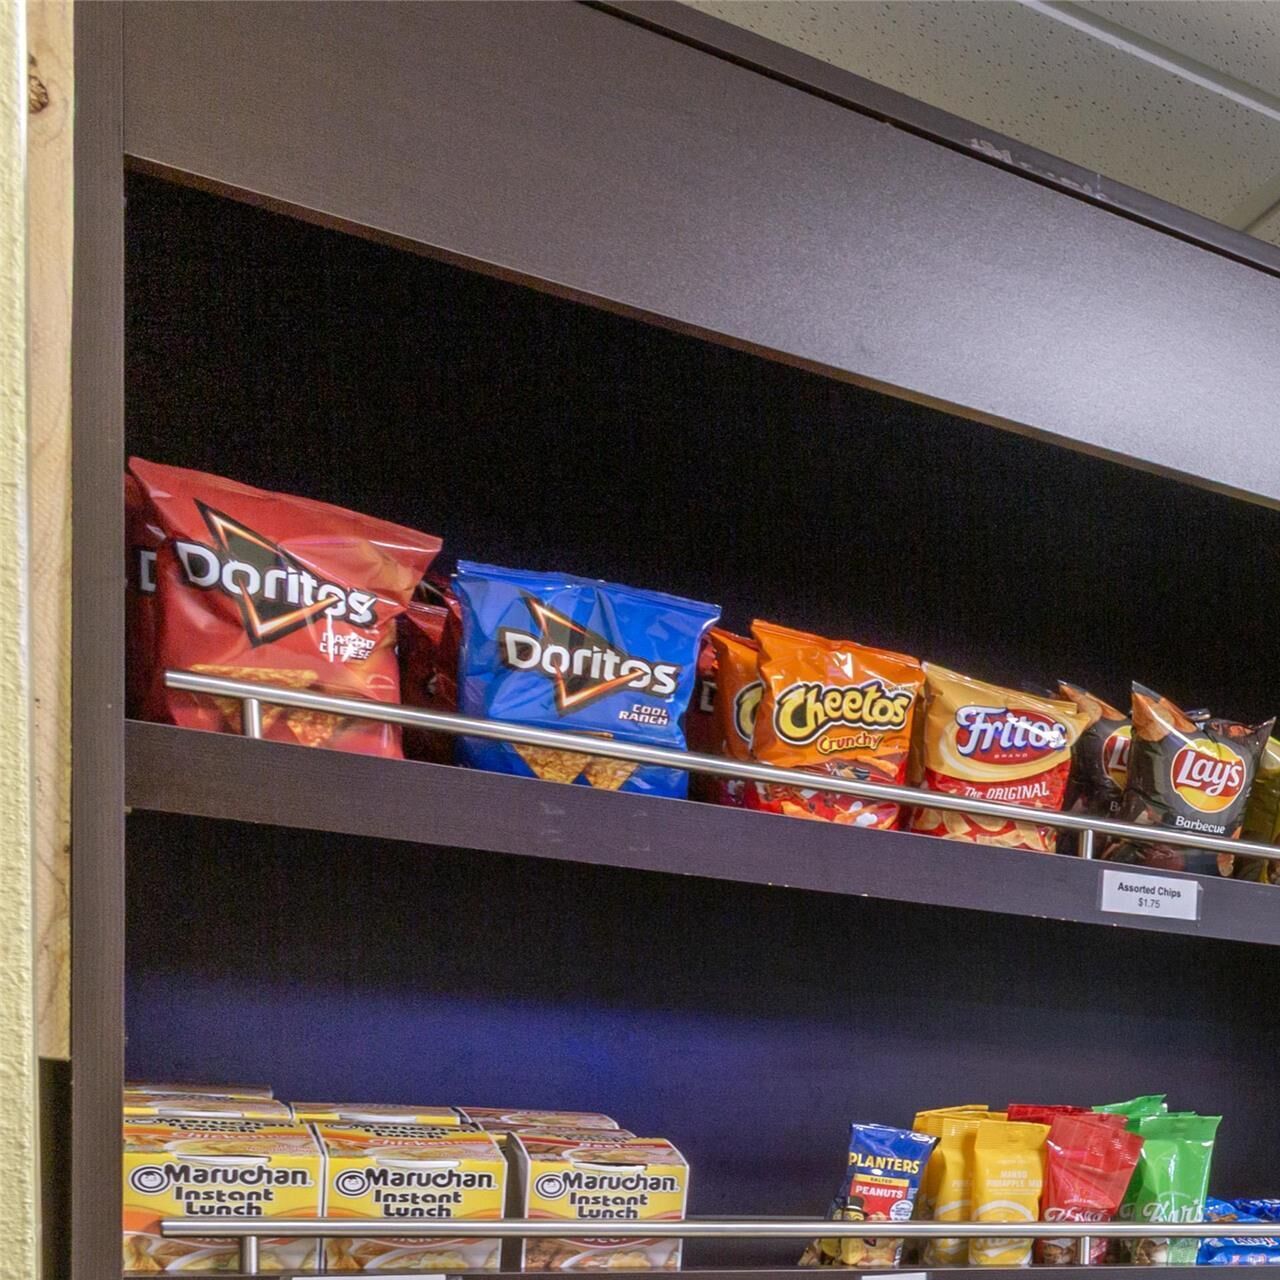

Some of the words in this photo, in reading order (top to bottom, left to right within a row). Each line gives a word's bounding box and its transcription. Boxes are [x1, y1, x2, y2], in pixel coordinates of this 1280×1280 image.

[176, 540, 377, 624] Doritos
[504, 631, 678, 695] Doritos
[618, 710, 669, 726] RANCH
[632, 703, 669, 715] COOL
[776, 682, 911, 740] Cheetos
[955, 706, 1069, 756] Fritos
[816, 732, 883, 755] Crunchy
[1175, 750, 1243, 797] Lay's
[964, 785, 983, 799] The
[985, 781, 1050, 801] ORIGINAL
[1175, 815, 1227, 834] Barbecue
[1117, 882, 1156, 895] Assorted
[1157, 886, 1182, 899] Chips
[1137, 897, 1161, 909] $1.75
[848, 1152, 921, 1175] PLANTERS
[163, 1163, 308, 1186] Maruchan
[365, 1168, 493, 1188] Maruchan
[562, 1172, 676, 1191] Maruchan
[175, 1186, 274, 1203] Instant
[374, 1189, 463, 1205] Instant
[569, 1192, 648, 1207] Instant
[855, 1184, 904, 1199] PEANUTS
[186, 1201, 263, 1215] Lunch
[383, 1204, 452, 1217] Lunch
[577, 1206, 639, 1219] Lunch
